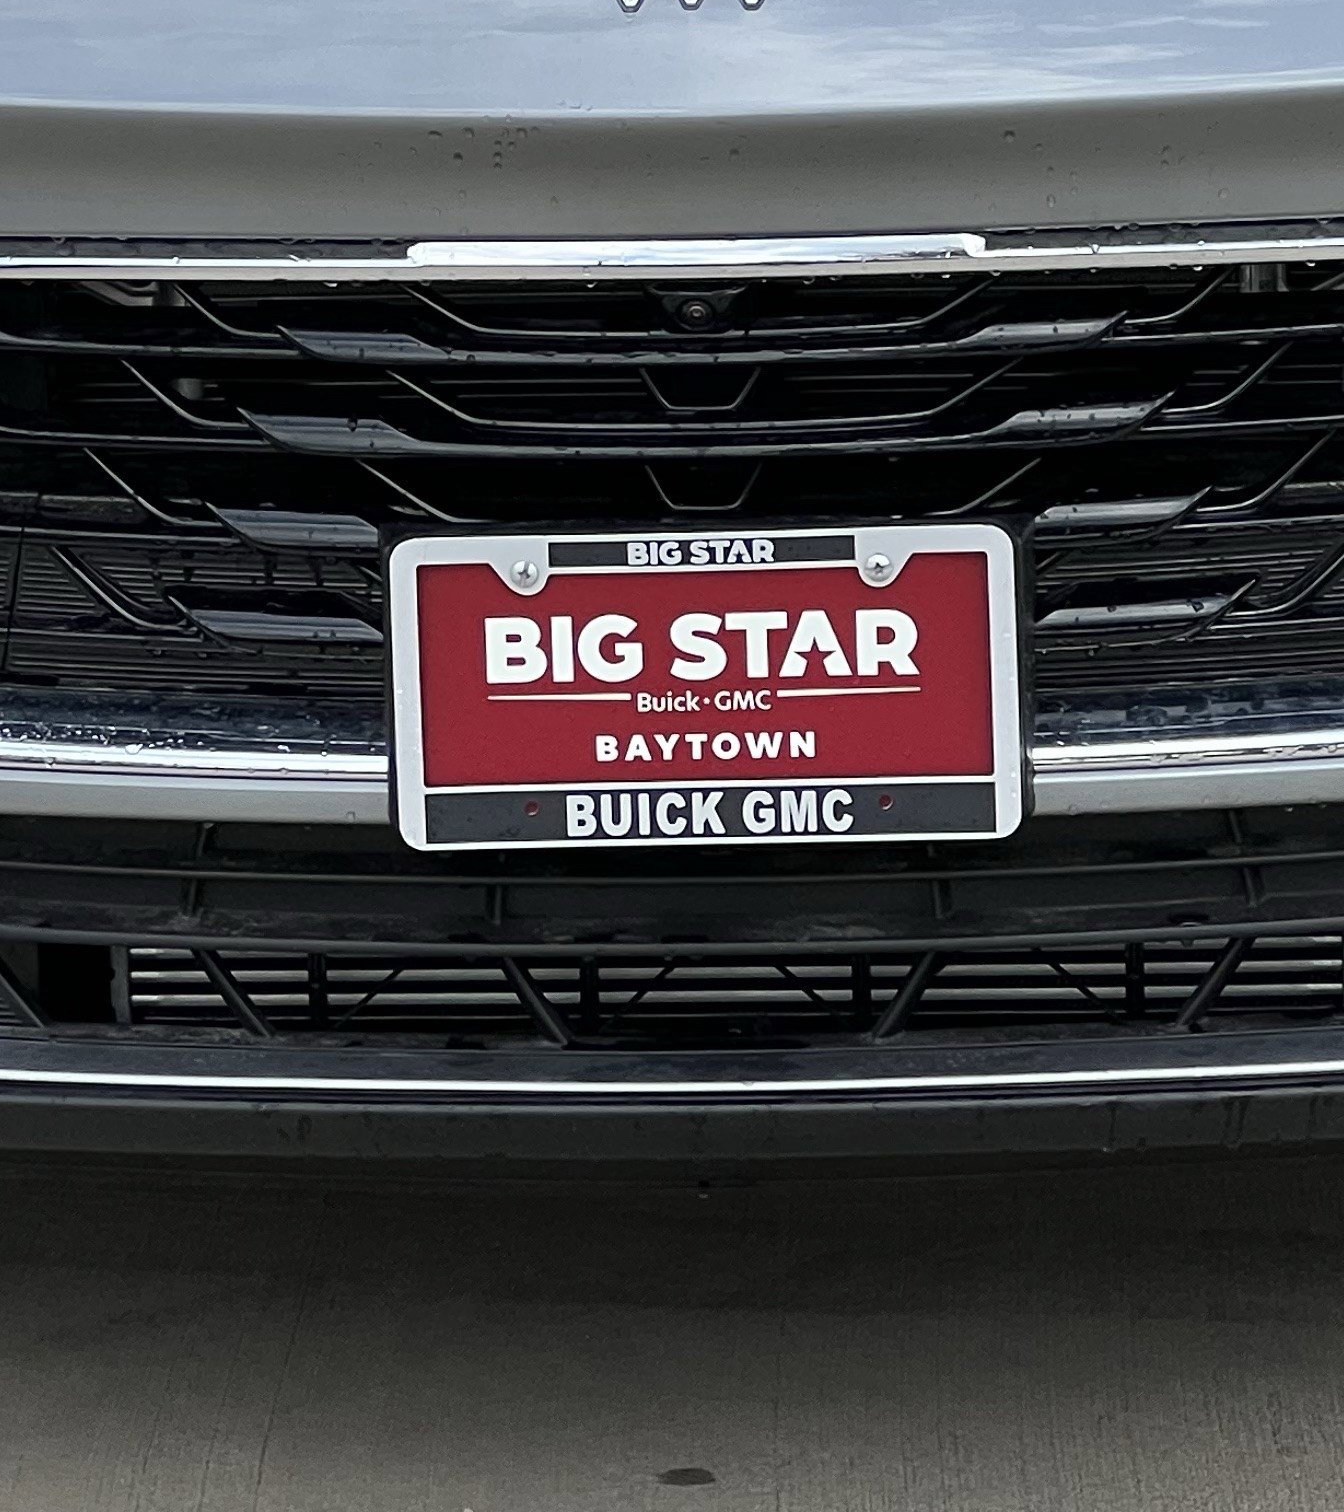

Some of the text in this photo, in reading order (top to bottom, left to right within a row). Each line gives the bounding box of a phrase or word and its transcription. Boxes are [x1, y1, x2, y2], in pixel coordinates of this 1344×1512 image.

[628, 539, 775, 565] BIG STAR
[485, 609, 919, 683] BIG STAR
[637, 690, 771, 712] Buick GMC
[596, 731, 815, 761] BAYTOWN
[566, 789, 854, 836] BUICK GMC
